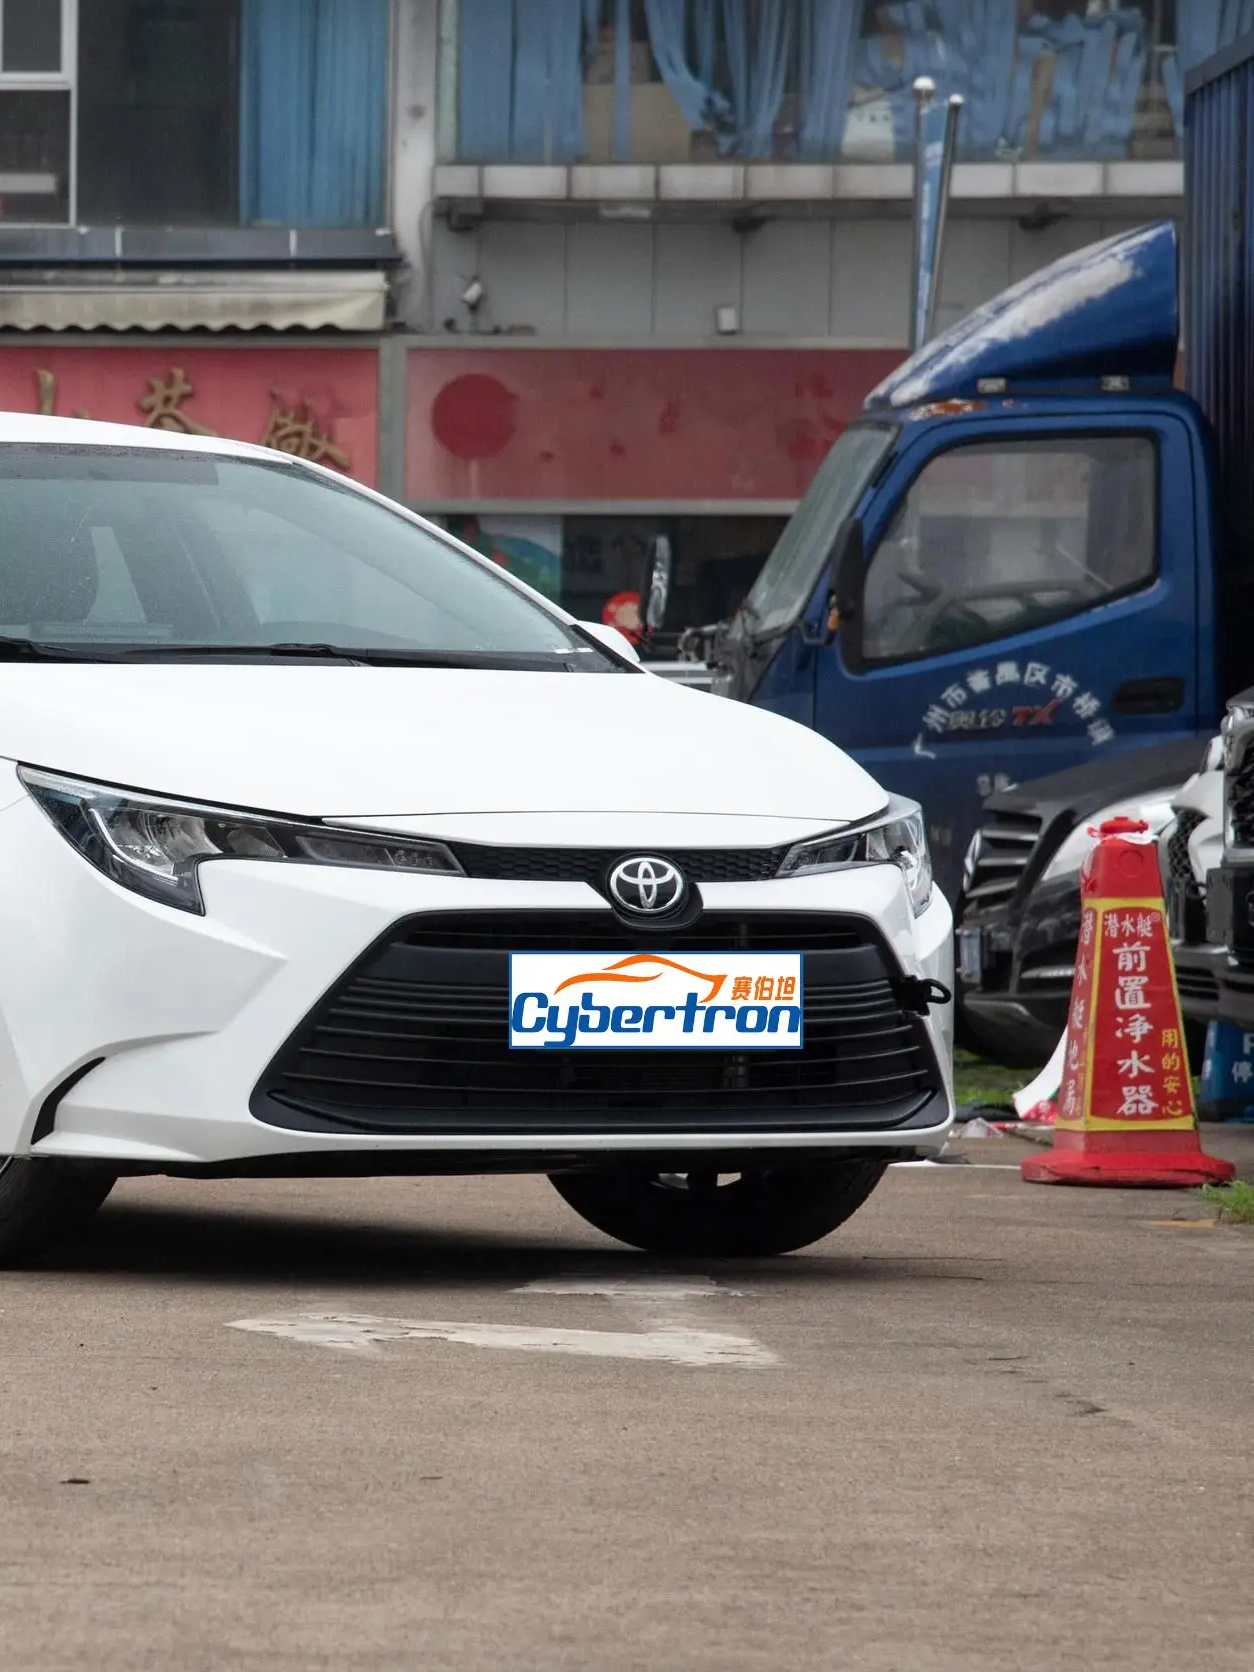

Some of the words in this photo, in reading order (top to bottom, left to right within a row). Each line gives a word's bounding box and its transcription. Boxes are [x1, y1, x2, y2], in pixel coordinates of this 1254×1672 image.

[1104, 911, 1154, 939] 潜水艇
[1112, 941, 1159, 1116] 前置净水器
[1161, 1028, 1183, 1116] 用的安心
